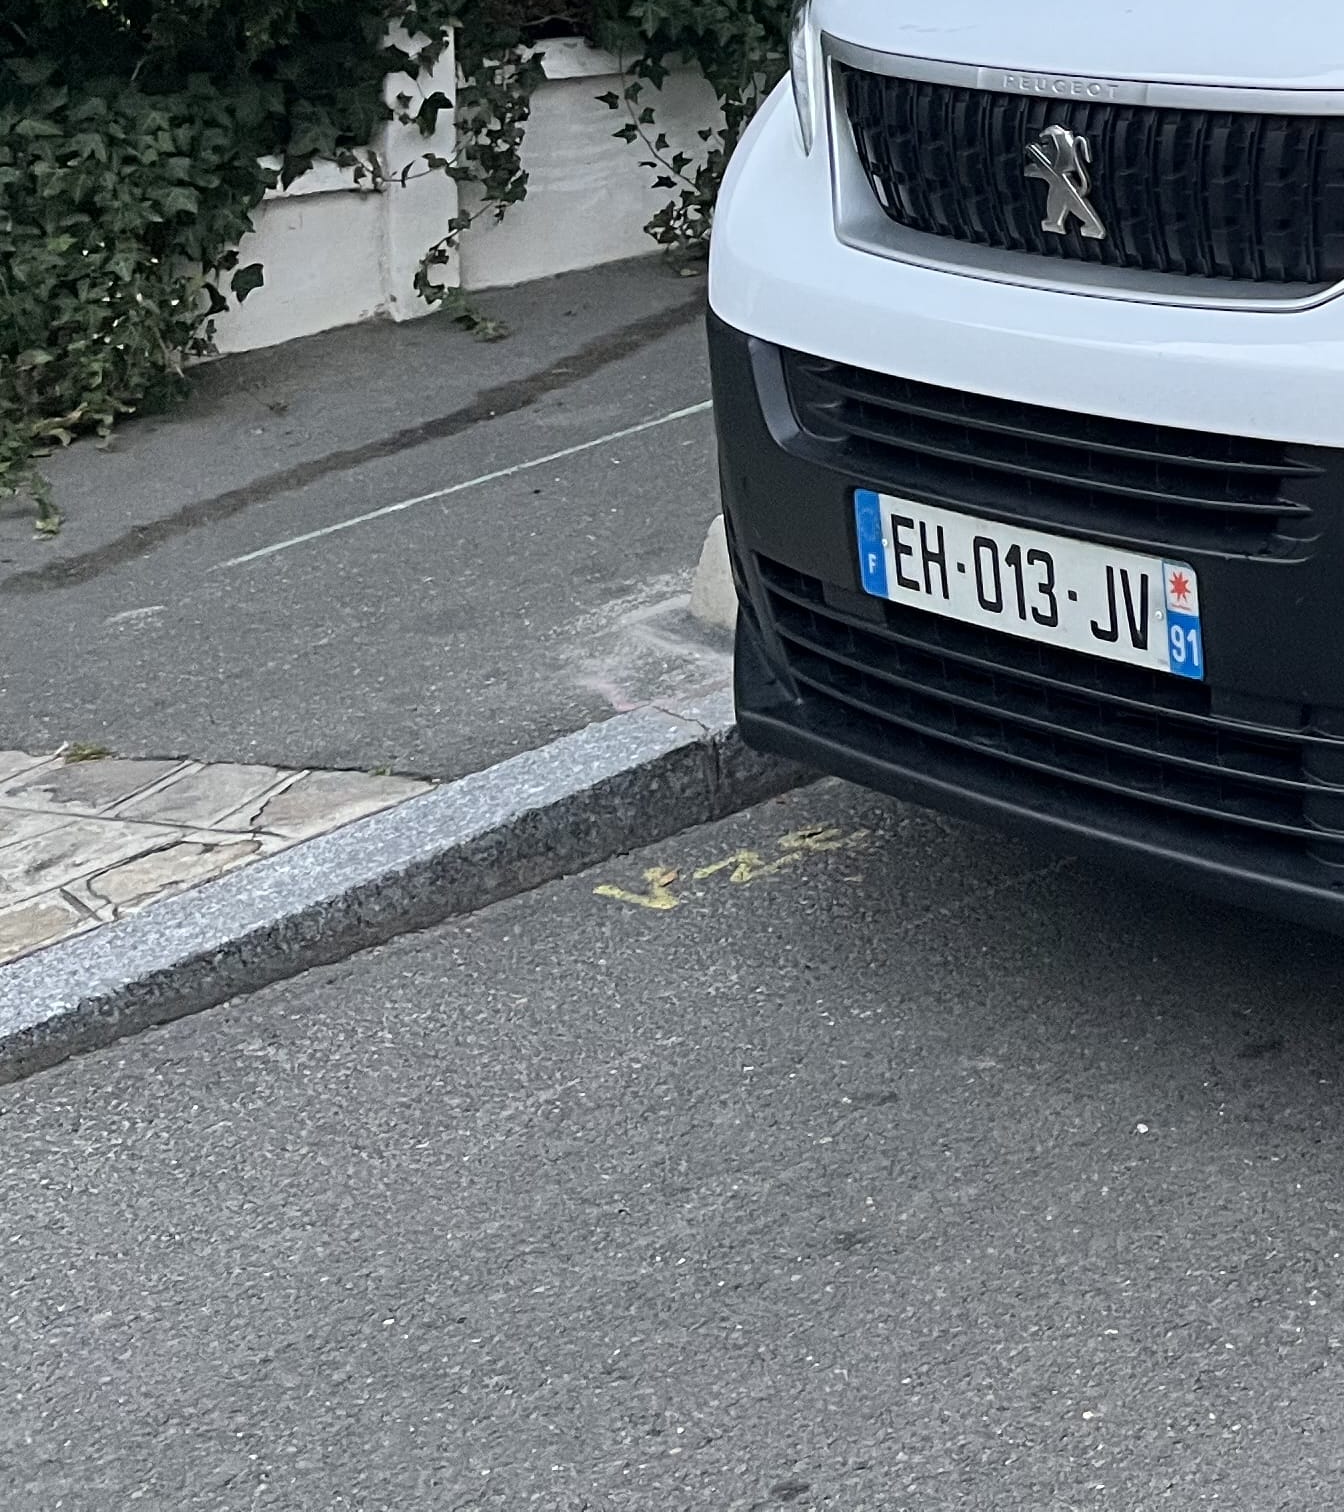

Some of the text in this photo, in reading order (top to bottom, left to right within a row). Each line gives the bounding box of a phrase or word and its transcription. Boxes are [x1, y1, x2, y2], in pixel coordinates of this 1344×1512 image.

[1003, 74, 1119, 99] PEUGEOT
[868, 553, 877, 574] F
[1171, 624, 1199, 666] 91
